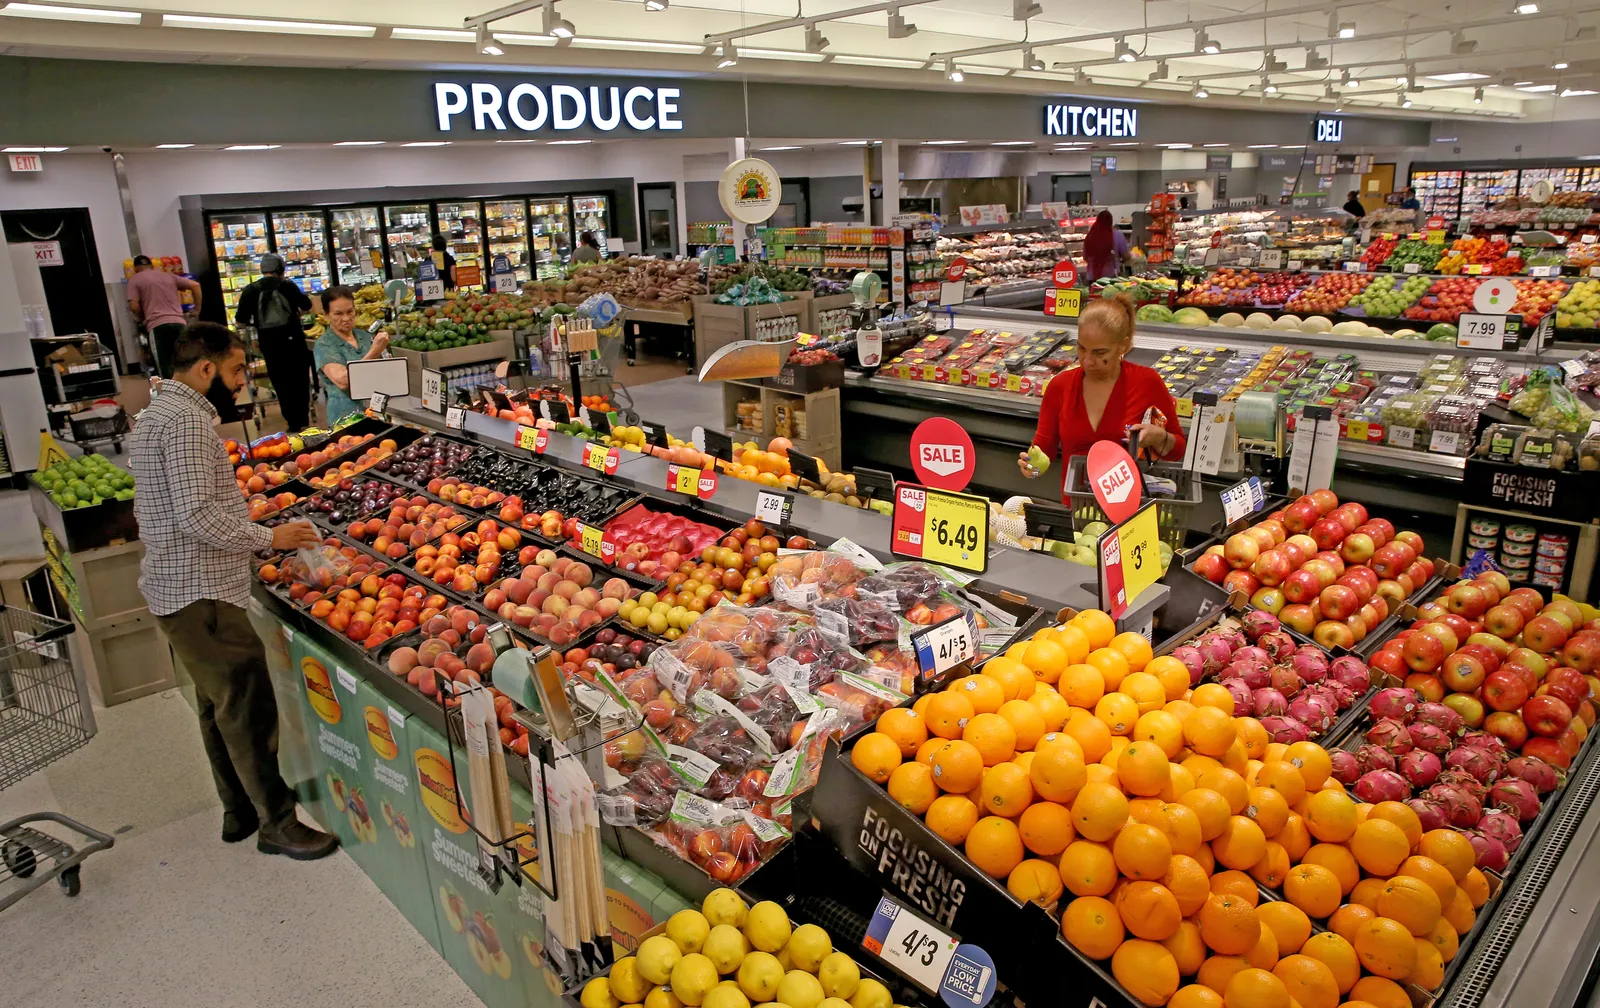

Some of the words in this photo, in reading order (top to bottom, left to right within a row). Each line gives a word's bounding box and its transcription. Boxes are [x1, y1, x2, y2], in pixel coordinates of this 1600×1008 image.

[434, 82, 683, 132] PRODUCE
[1046, 104, 1138, 137] KITCHEN
[1317, 119, 1342, 142] DELI
[15, 156, 37, 171] EXIT
[34, 249, 54, 260] XIT
[428, 285, 439, 295] 2/3
[923, 447, 962, 464] SALE
[699, 478, 714, 488] SALE
[1102, 464, 1131, 496] SALE
[1493, 472, 1556, 493] FOCUSING
[902, 490, 924, 501] SALE
[1492, 485, 1504, 495] ON
[1505, 487, 1554, 508] FRESH
[931, 517, 978, 552] $6.49
[602, 542, 614, 552] SALE
[1105, 540, 1119, 560] SALE
[940, 635, 967, 660] 4/$5
[319, 723, 361, 760] Summer's
[319, 736, 359, 772] Sweetest
[374, 758, 409, 788] Summer's
[374, 767, 406, 795] Sweetest
[433, 827, 480, 871] Summe
[863, 805, 966, 907] FOCUSING
[431, 839, 491, 896] Sweetest
[859, 829, 880, 856] ON
[878, 846, 958, 931] FRESH
[883, 903, 895, 913] LOW
[901, 929, 939, 967] 4/$3
[952, 968, 977, 985] LOW
[954, 959, 981, 976] EVERYDAY
[947, 976, 975, 996] PRICE
